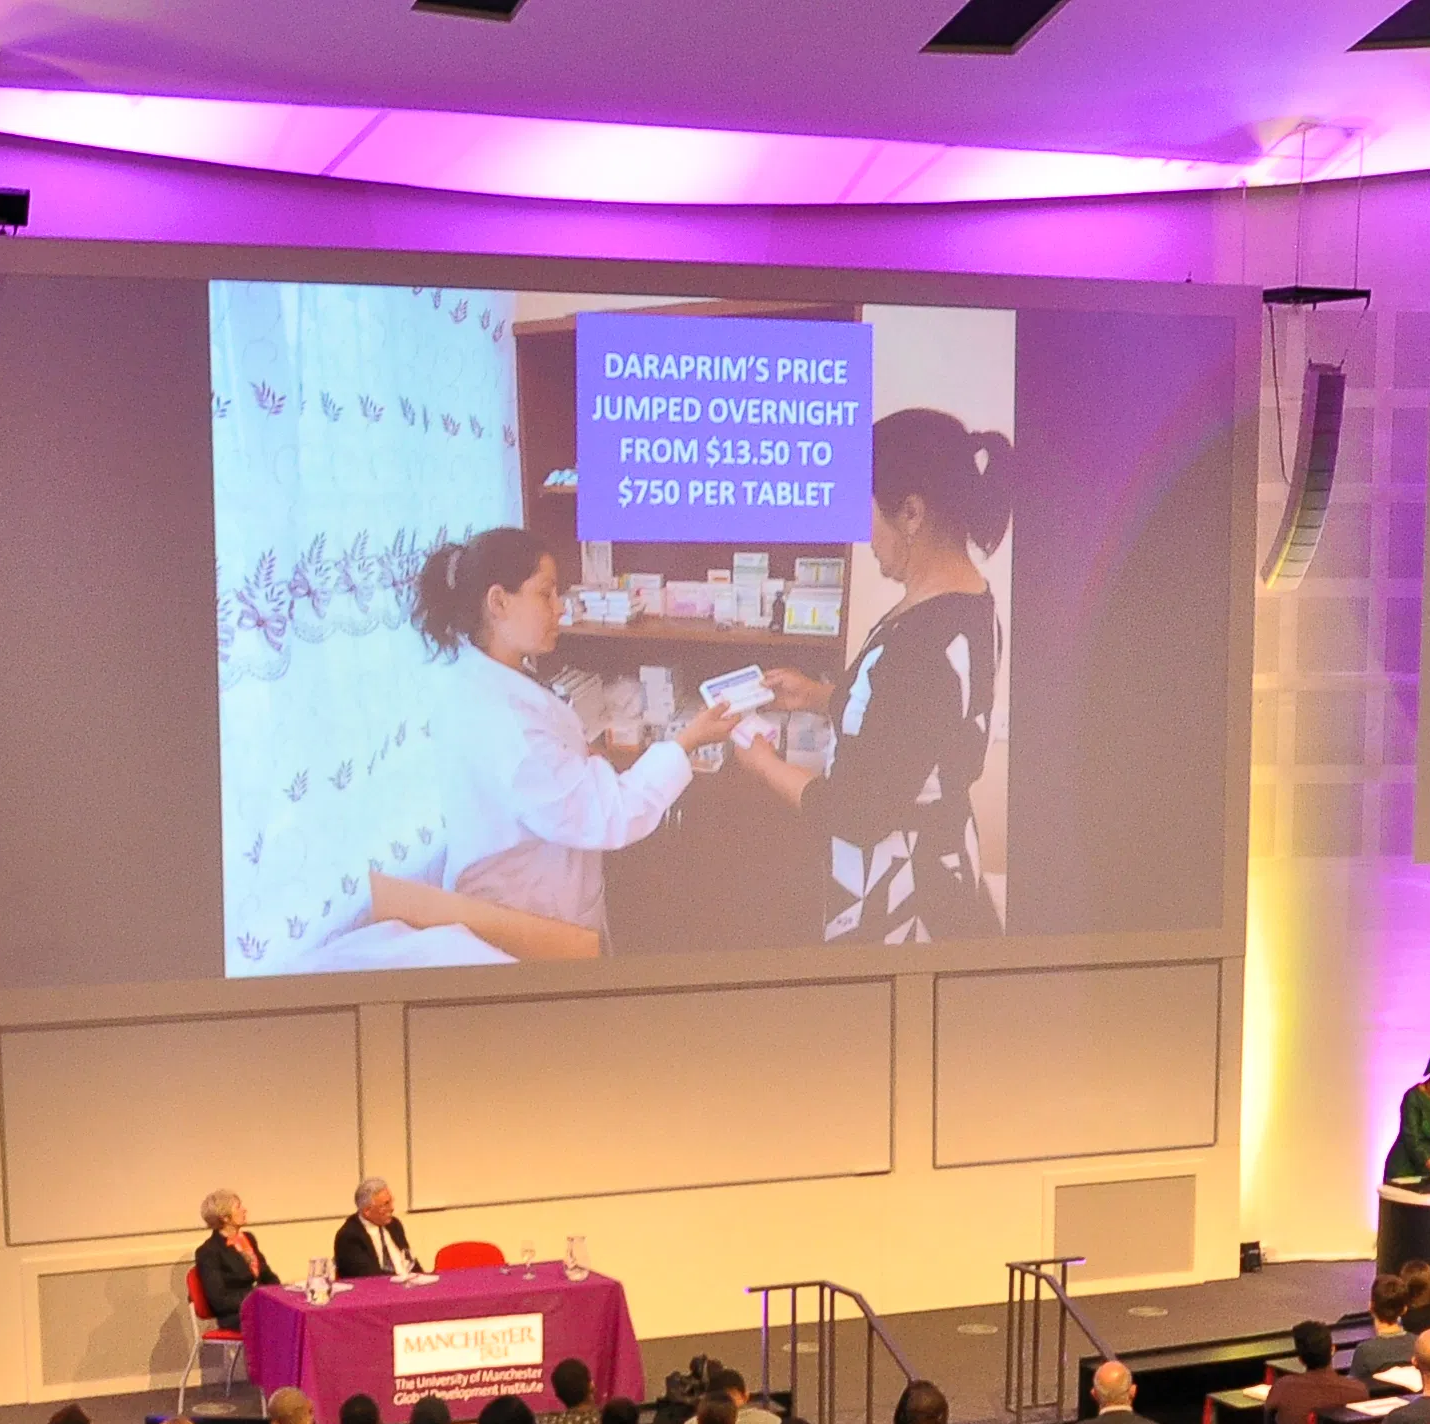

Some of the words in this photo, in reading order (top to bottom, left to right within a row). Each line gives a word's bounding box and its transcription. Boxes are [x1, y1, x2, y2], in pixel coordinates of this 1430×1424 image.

[604, 352, 769, 384] DARAPRIM’S
[777, 357, 848, 384] PRICE
[592, 395, 702, 424] JUMPED
[708, 396, 859, 426] OVERNIGHT
[620, 437, 698, 465] FROM
[706, 435, 790, 468] $13.50
[797, 441, 833, 466] TO
[618, 477, 681, 508] $750
[688, 480, 735, 505] PER
[743, 481, 835, 507] TABLET
[404, 1326, 535, 1354] MANCHESTER
[396, 1378, 415, 1391] The
[416, 1372, 469, 1389] University
[470, 1370, 482, 1383] of
[482, 1367, 543, 1383] Manchester
[500, 1381, 544, 1395] Institute
